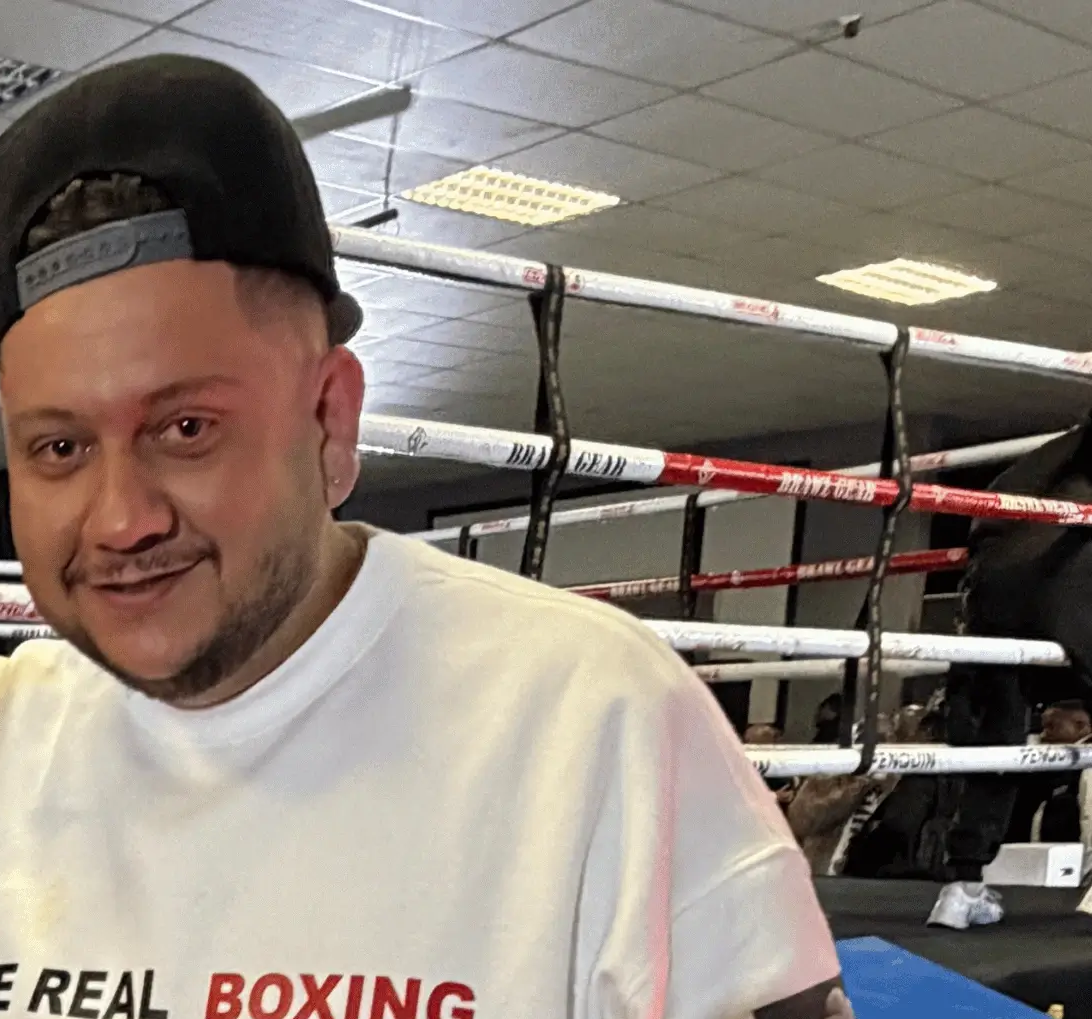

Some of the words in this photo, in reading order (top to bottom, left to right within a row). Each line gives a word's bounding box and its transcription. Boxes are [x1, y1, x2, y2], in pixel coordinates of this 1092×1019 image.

[507, 442, 549, 469] BRA
[575, 450, 628, 477] GEAR
[776, 471, 830, 497] BRAWL
